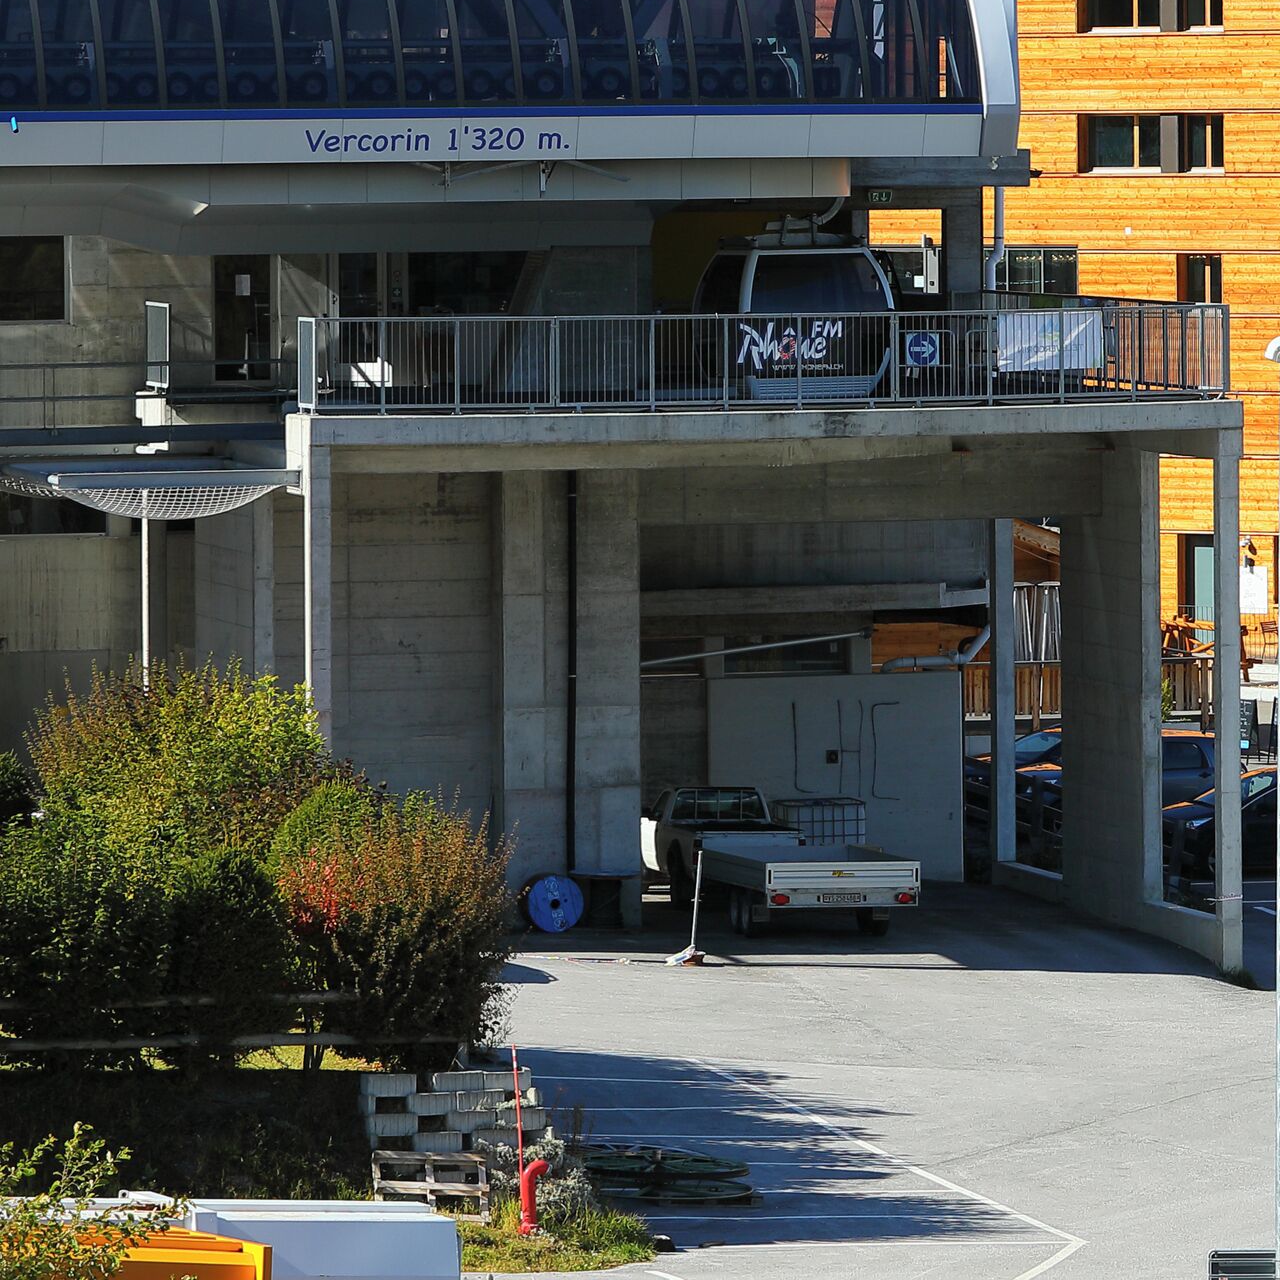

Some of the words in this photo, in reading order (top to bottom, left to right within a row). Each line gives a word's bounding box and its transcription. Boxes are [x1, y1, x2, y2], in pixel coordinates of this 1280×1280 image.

[305, 127, 430, 152] Vercorin
[447, 125, 525, 151] 1'320
[538, 130, 570, 149] m.
[737, 321, 827, 370] Rhône
[811, 320, 843, 338] FM
